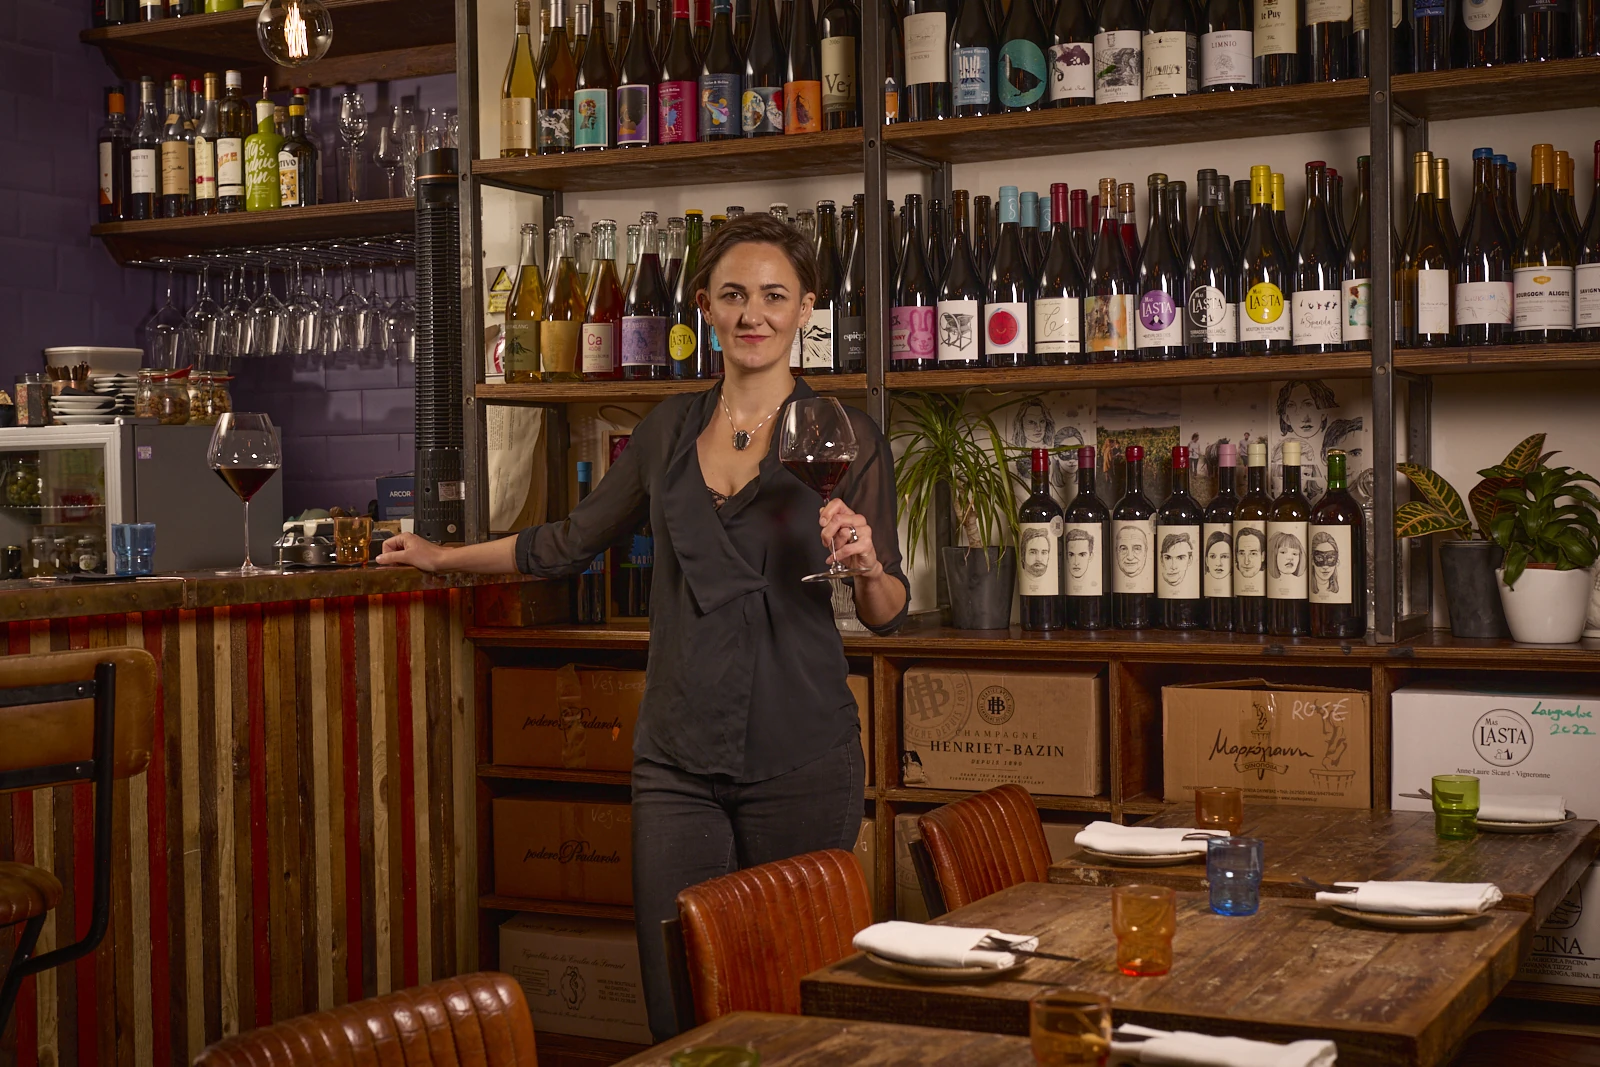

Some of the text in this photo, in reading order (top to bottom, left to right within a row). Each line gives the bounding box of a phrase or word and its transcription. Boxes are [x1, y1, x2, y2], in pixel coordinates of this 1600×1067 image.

[825, 73, 852, 100] Vej
[1142, 301, 1172, 318] LASTA
[1192, 297, 1223, 313] LASTA
[1250, 295, 1281, 310] LASTA
[587, 333, 603, 346] Ca
[670, 332, 693, 349] LASTA
[955, 729, 1039, 740] CHAMPAGNE
[1480, 726, 1527, 747] LASTA
[930, 740, 1065, 757] HENRIET-BAZIN
[1456, 767, 1490, 776] Anne-Laure
[1491, 769, 1510, 777] Sicard
[1516, 770, 1550, 779] Vigneronne
[523, 840, 620, 865] podere Pradarolo
[1565, 958, 1589, 967] PACINA
